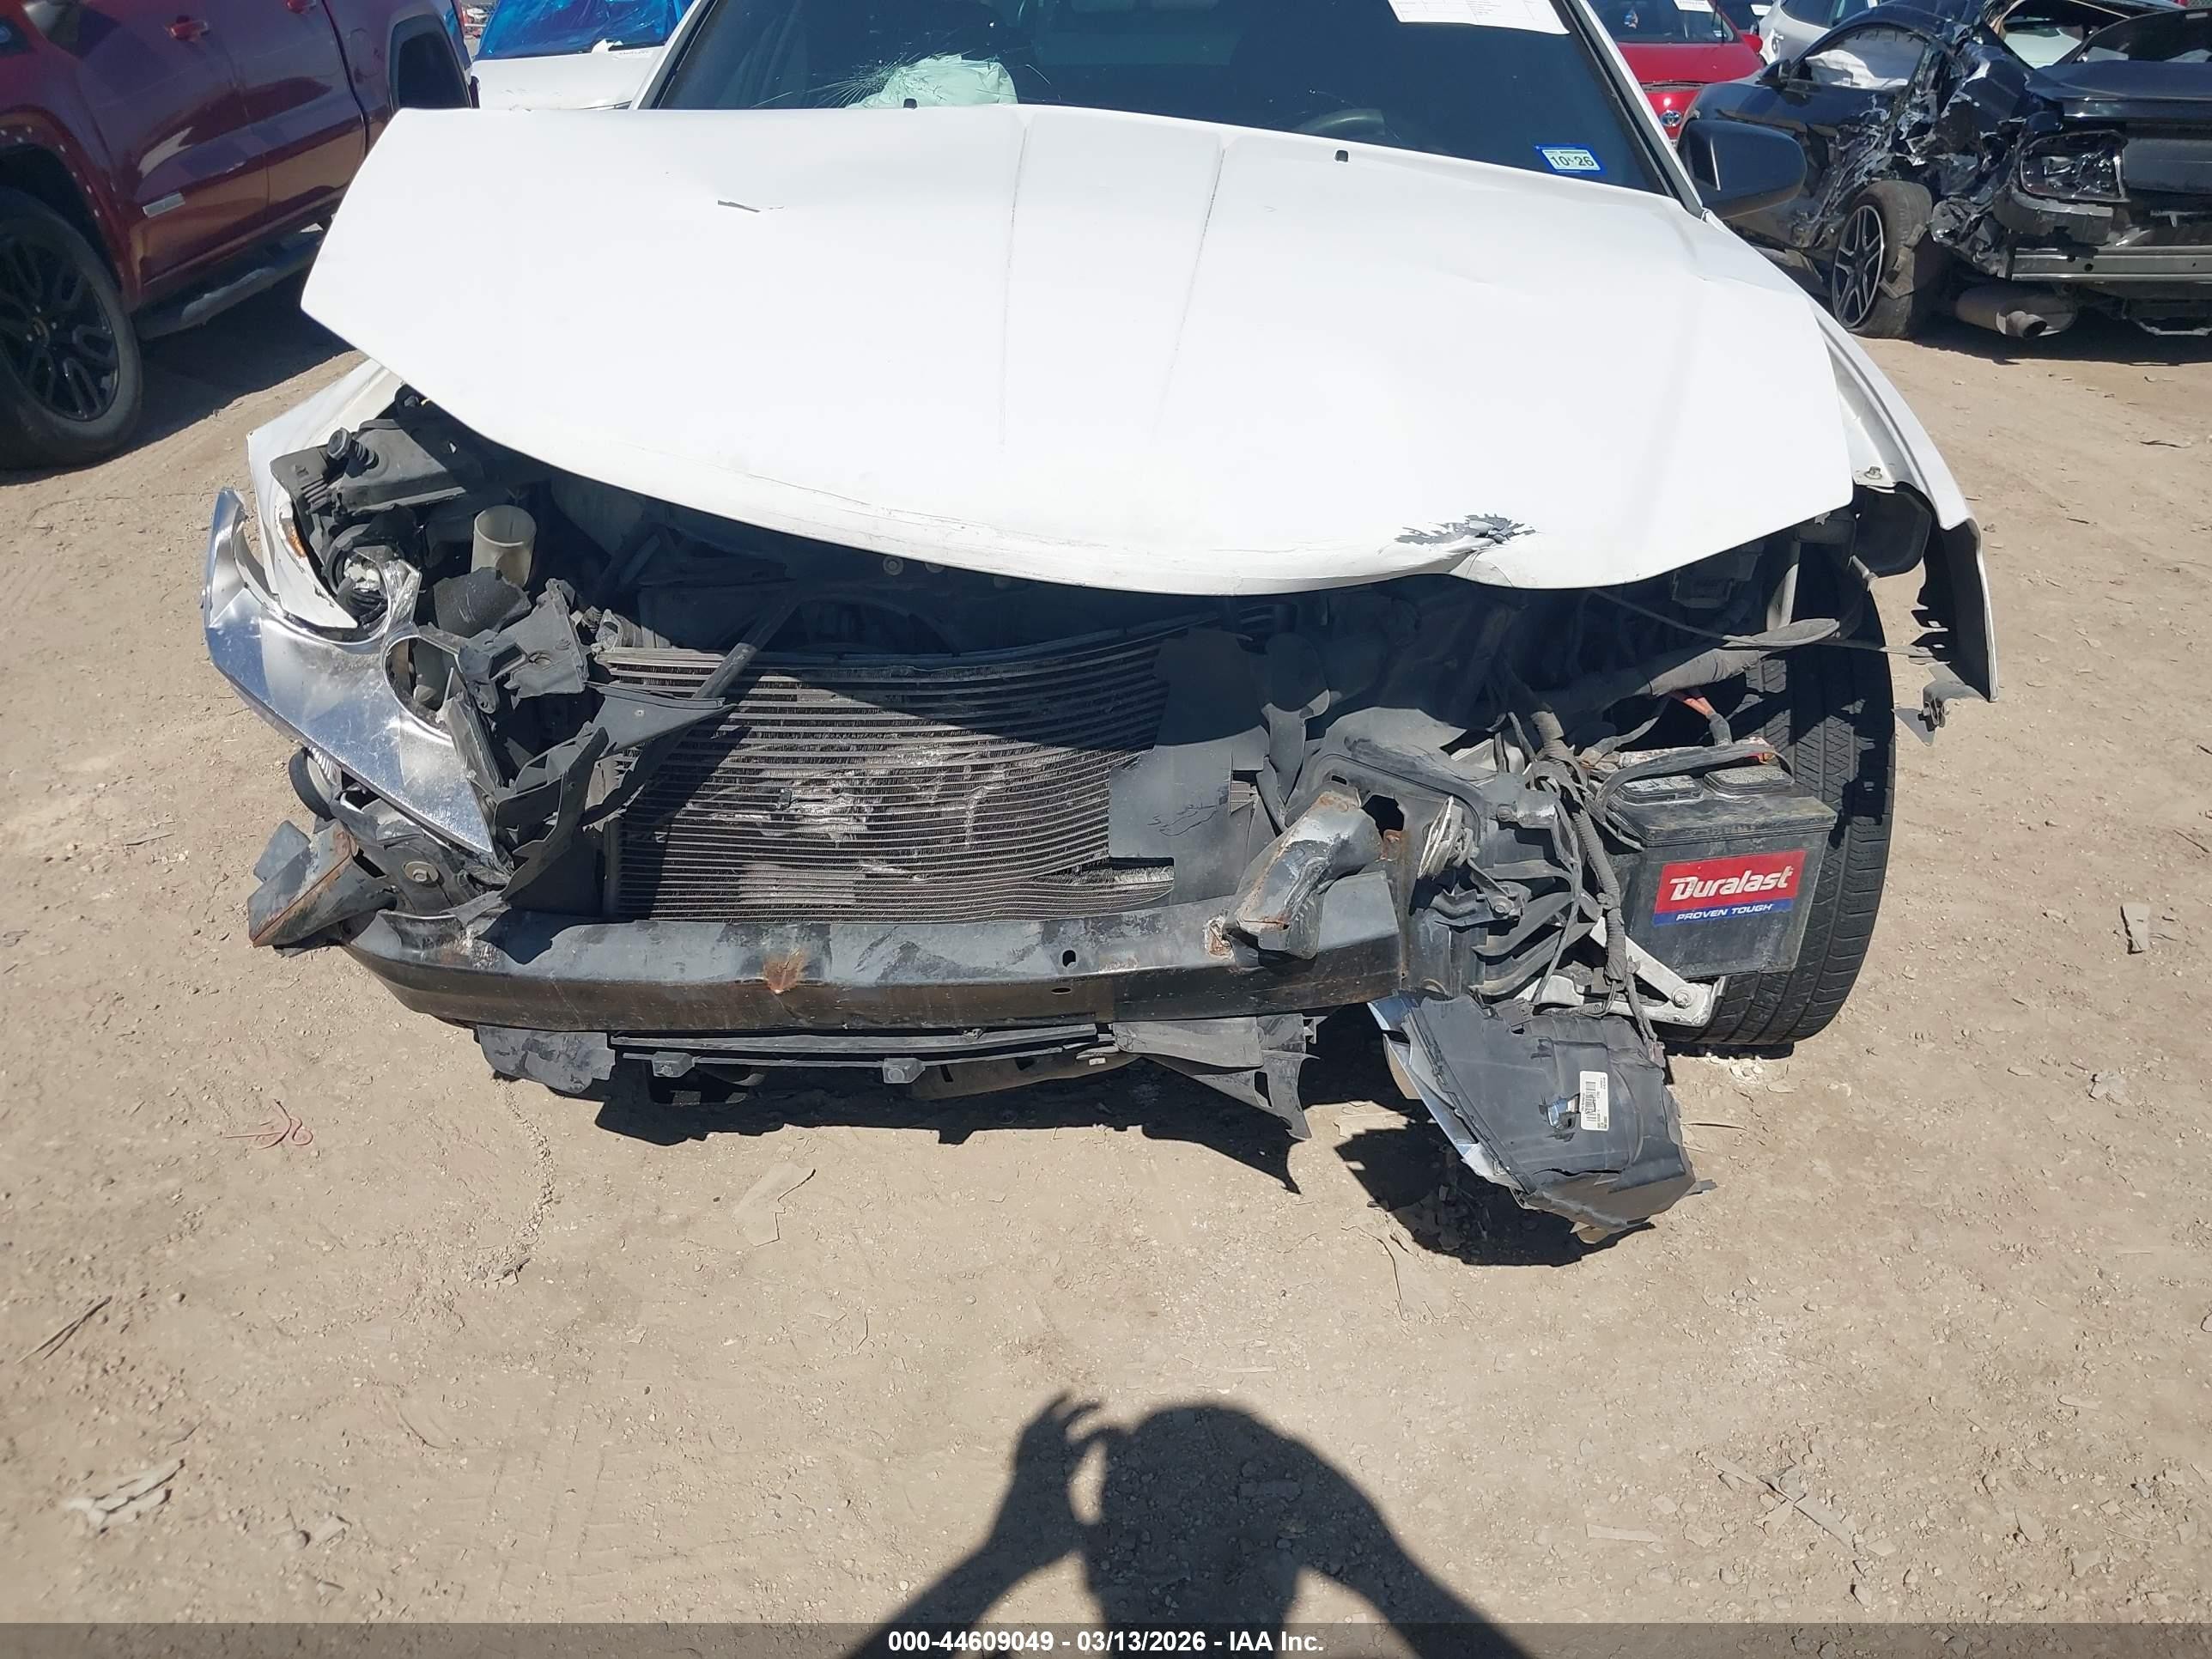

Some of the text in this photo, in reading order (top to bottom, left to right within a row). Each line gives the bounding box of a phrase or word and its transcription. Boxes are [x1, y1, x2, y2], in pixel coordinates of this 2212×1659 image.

[1550, 155, 1595, 167] 10 26
[1669, 865, 1795, 902] Duralast
[1675, 902, 1773, 921] PROVEN TOUGH
